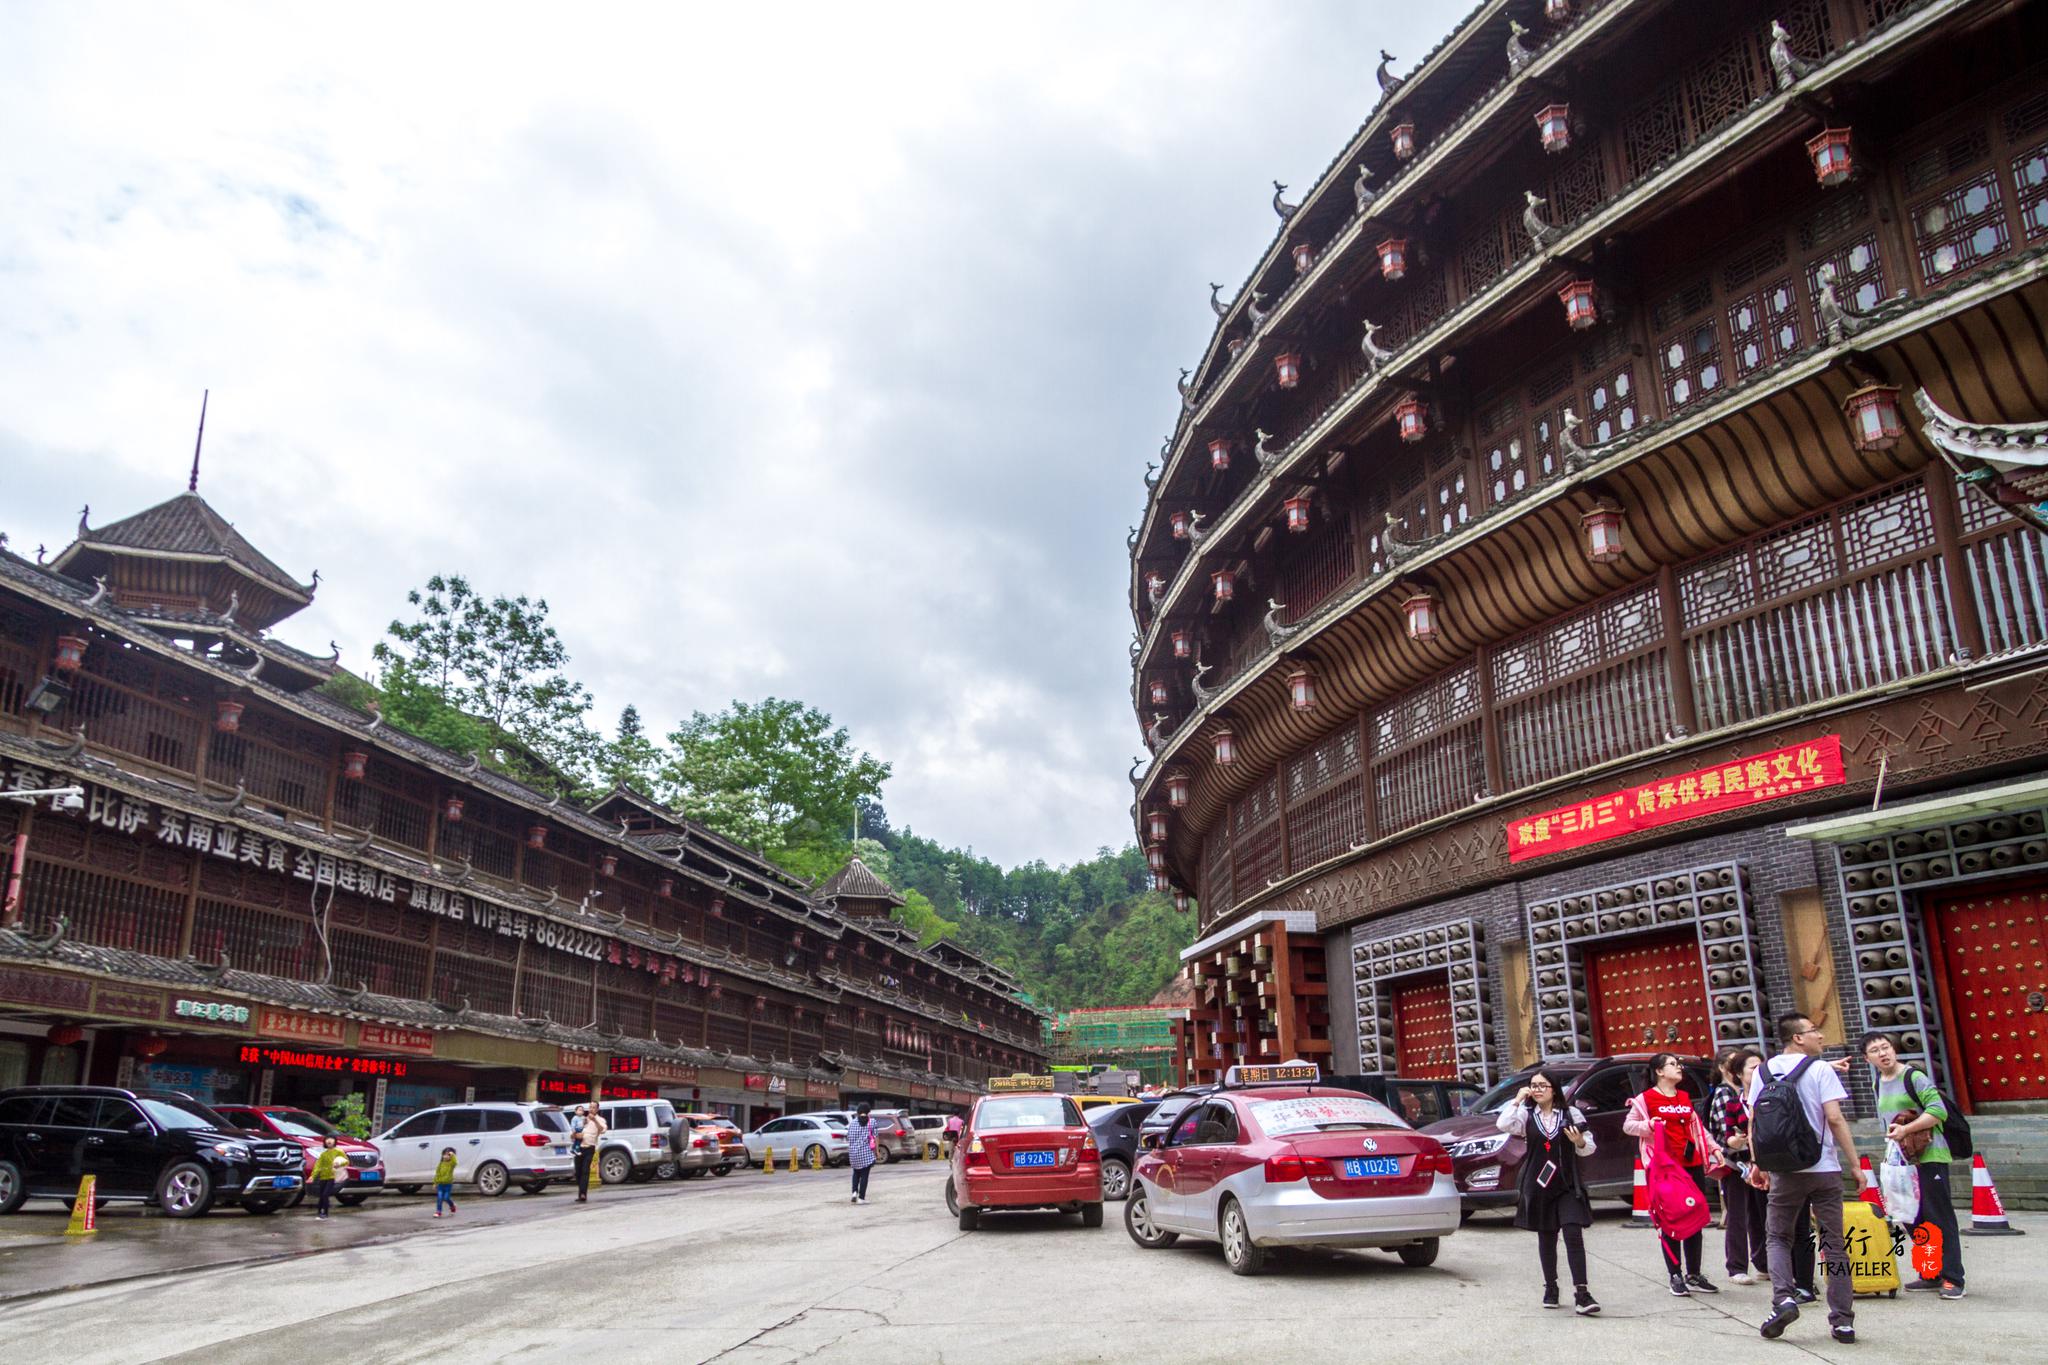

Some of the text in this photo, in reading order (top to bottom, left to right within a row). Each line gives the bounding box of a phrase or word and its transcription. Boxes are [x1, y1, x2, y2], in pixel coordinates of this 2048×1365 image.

[1240, 1067, 1317, 1082] 星期日 12:13:37
